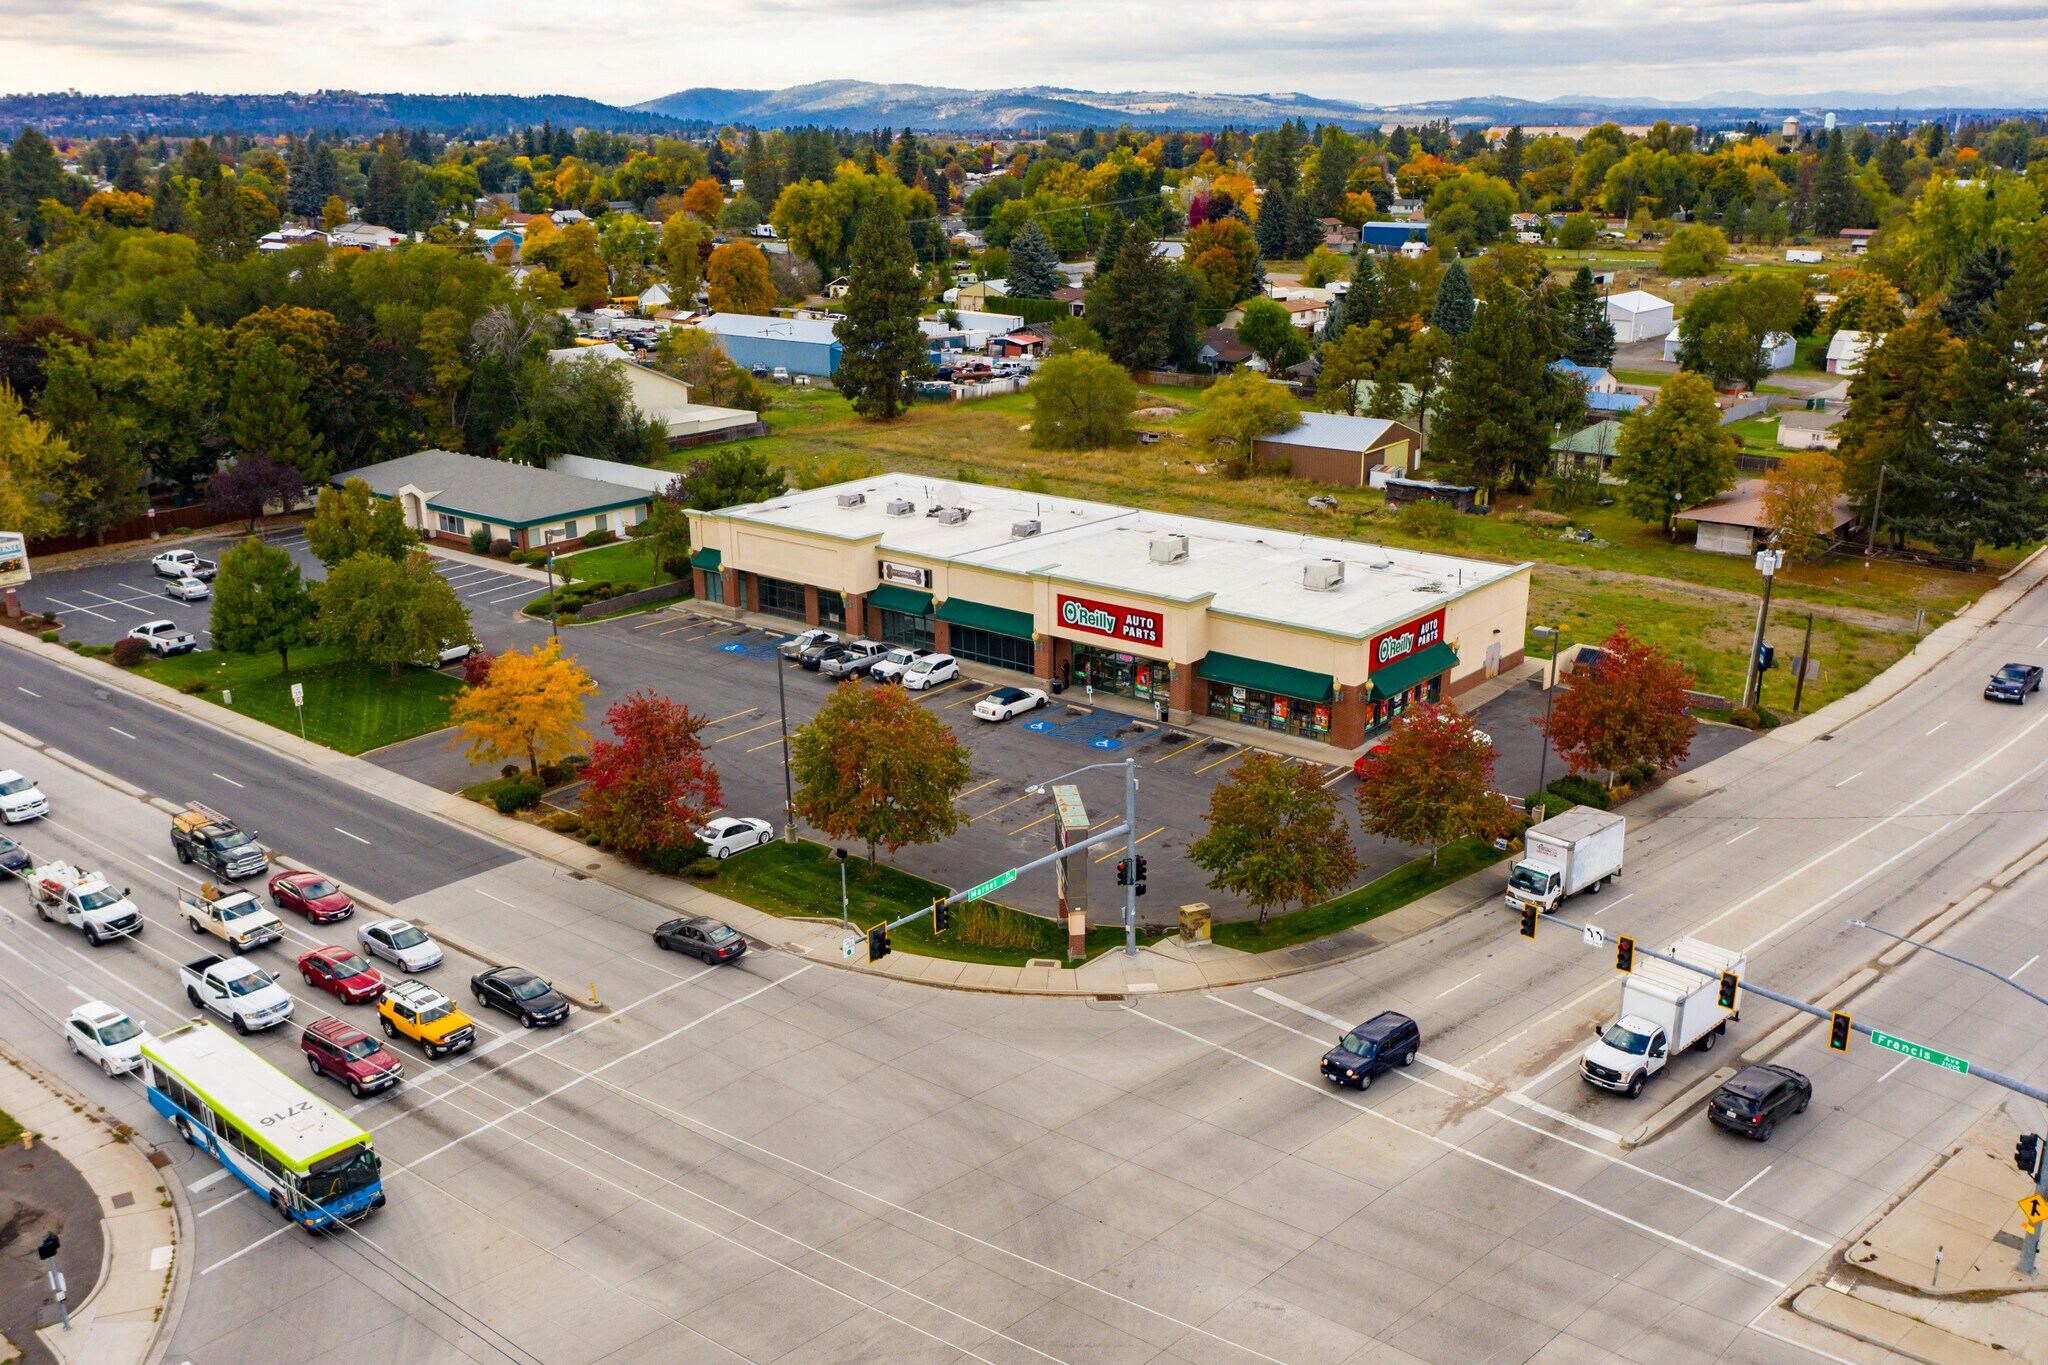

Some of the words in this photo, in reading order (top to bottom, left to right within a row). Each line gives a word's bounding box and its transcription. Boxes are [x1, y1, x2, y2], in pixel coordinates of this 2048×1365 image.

[1063, 600, 1116, 633] O'Reilly
[1126, 614, 1154, 629] AUTO
[1123, 625, 1156, 641] PARTS
[1420, 618, 1438, 635] AUTO
[1378, 632, 1414, 663] O'Reilly
[1417, 630, 1438, 647] PARTS
[970, 880, 997, 898] Market
[1878, 1035, 1931, 1060] Francis
[1944, 1056, 1960, 1065] Ave
[259, 1101, 313, 1127] 2716
